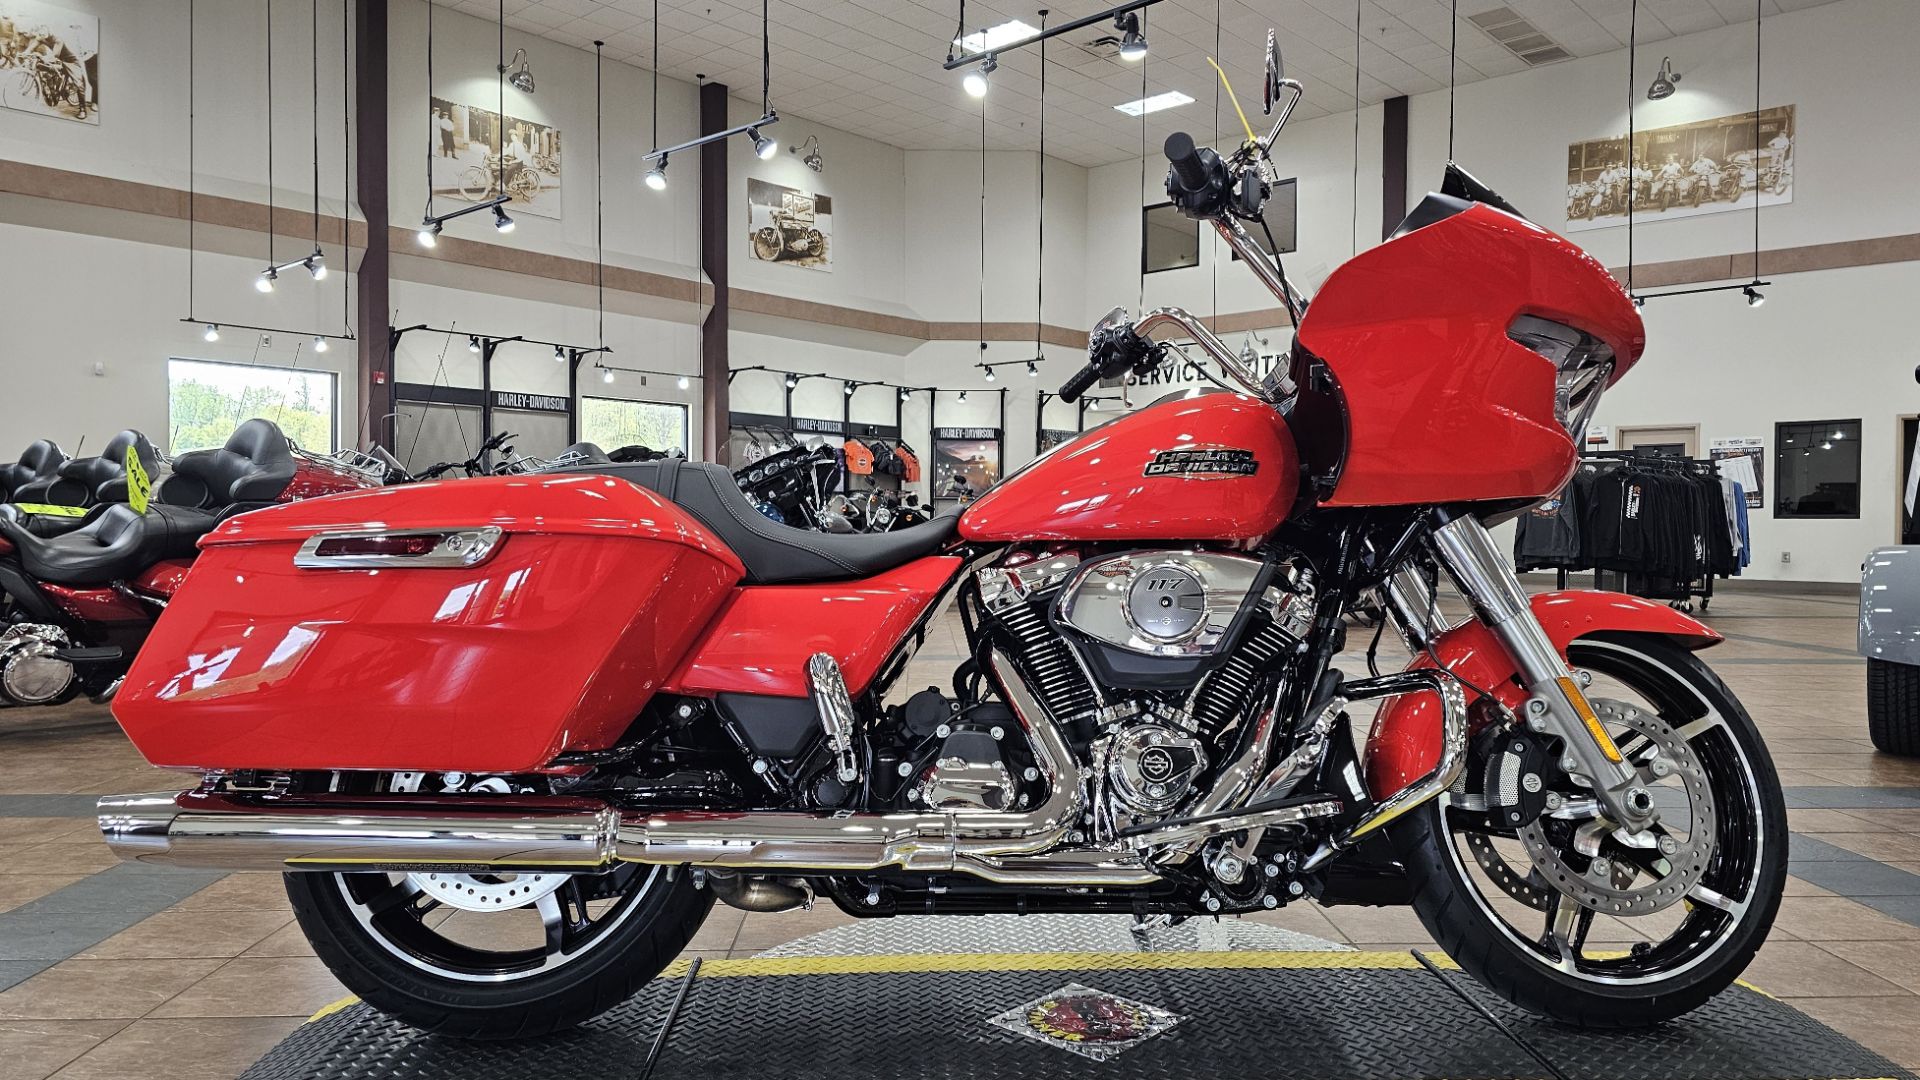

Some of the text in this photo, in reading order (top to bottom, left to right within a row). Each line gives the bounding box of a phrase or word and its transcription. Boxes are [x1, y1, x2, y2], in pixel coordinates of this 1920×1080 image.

[498, 392, 566, 410] HARLEY-DAVIDSON
[796, 418, 843, 432] HARLEY-DAVIDSON
[940, 428, 995, 439] HARLEY-DAVIDSON
[1146, 577, 1187, 592] 117
